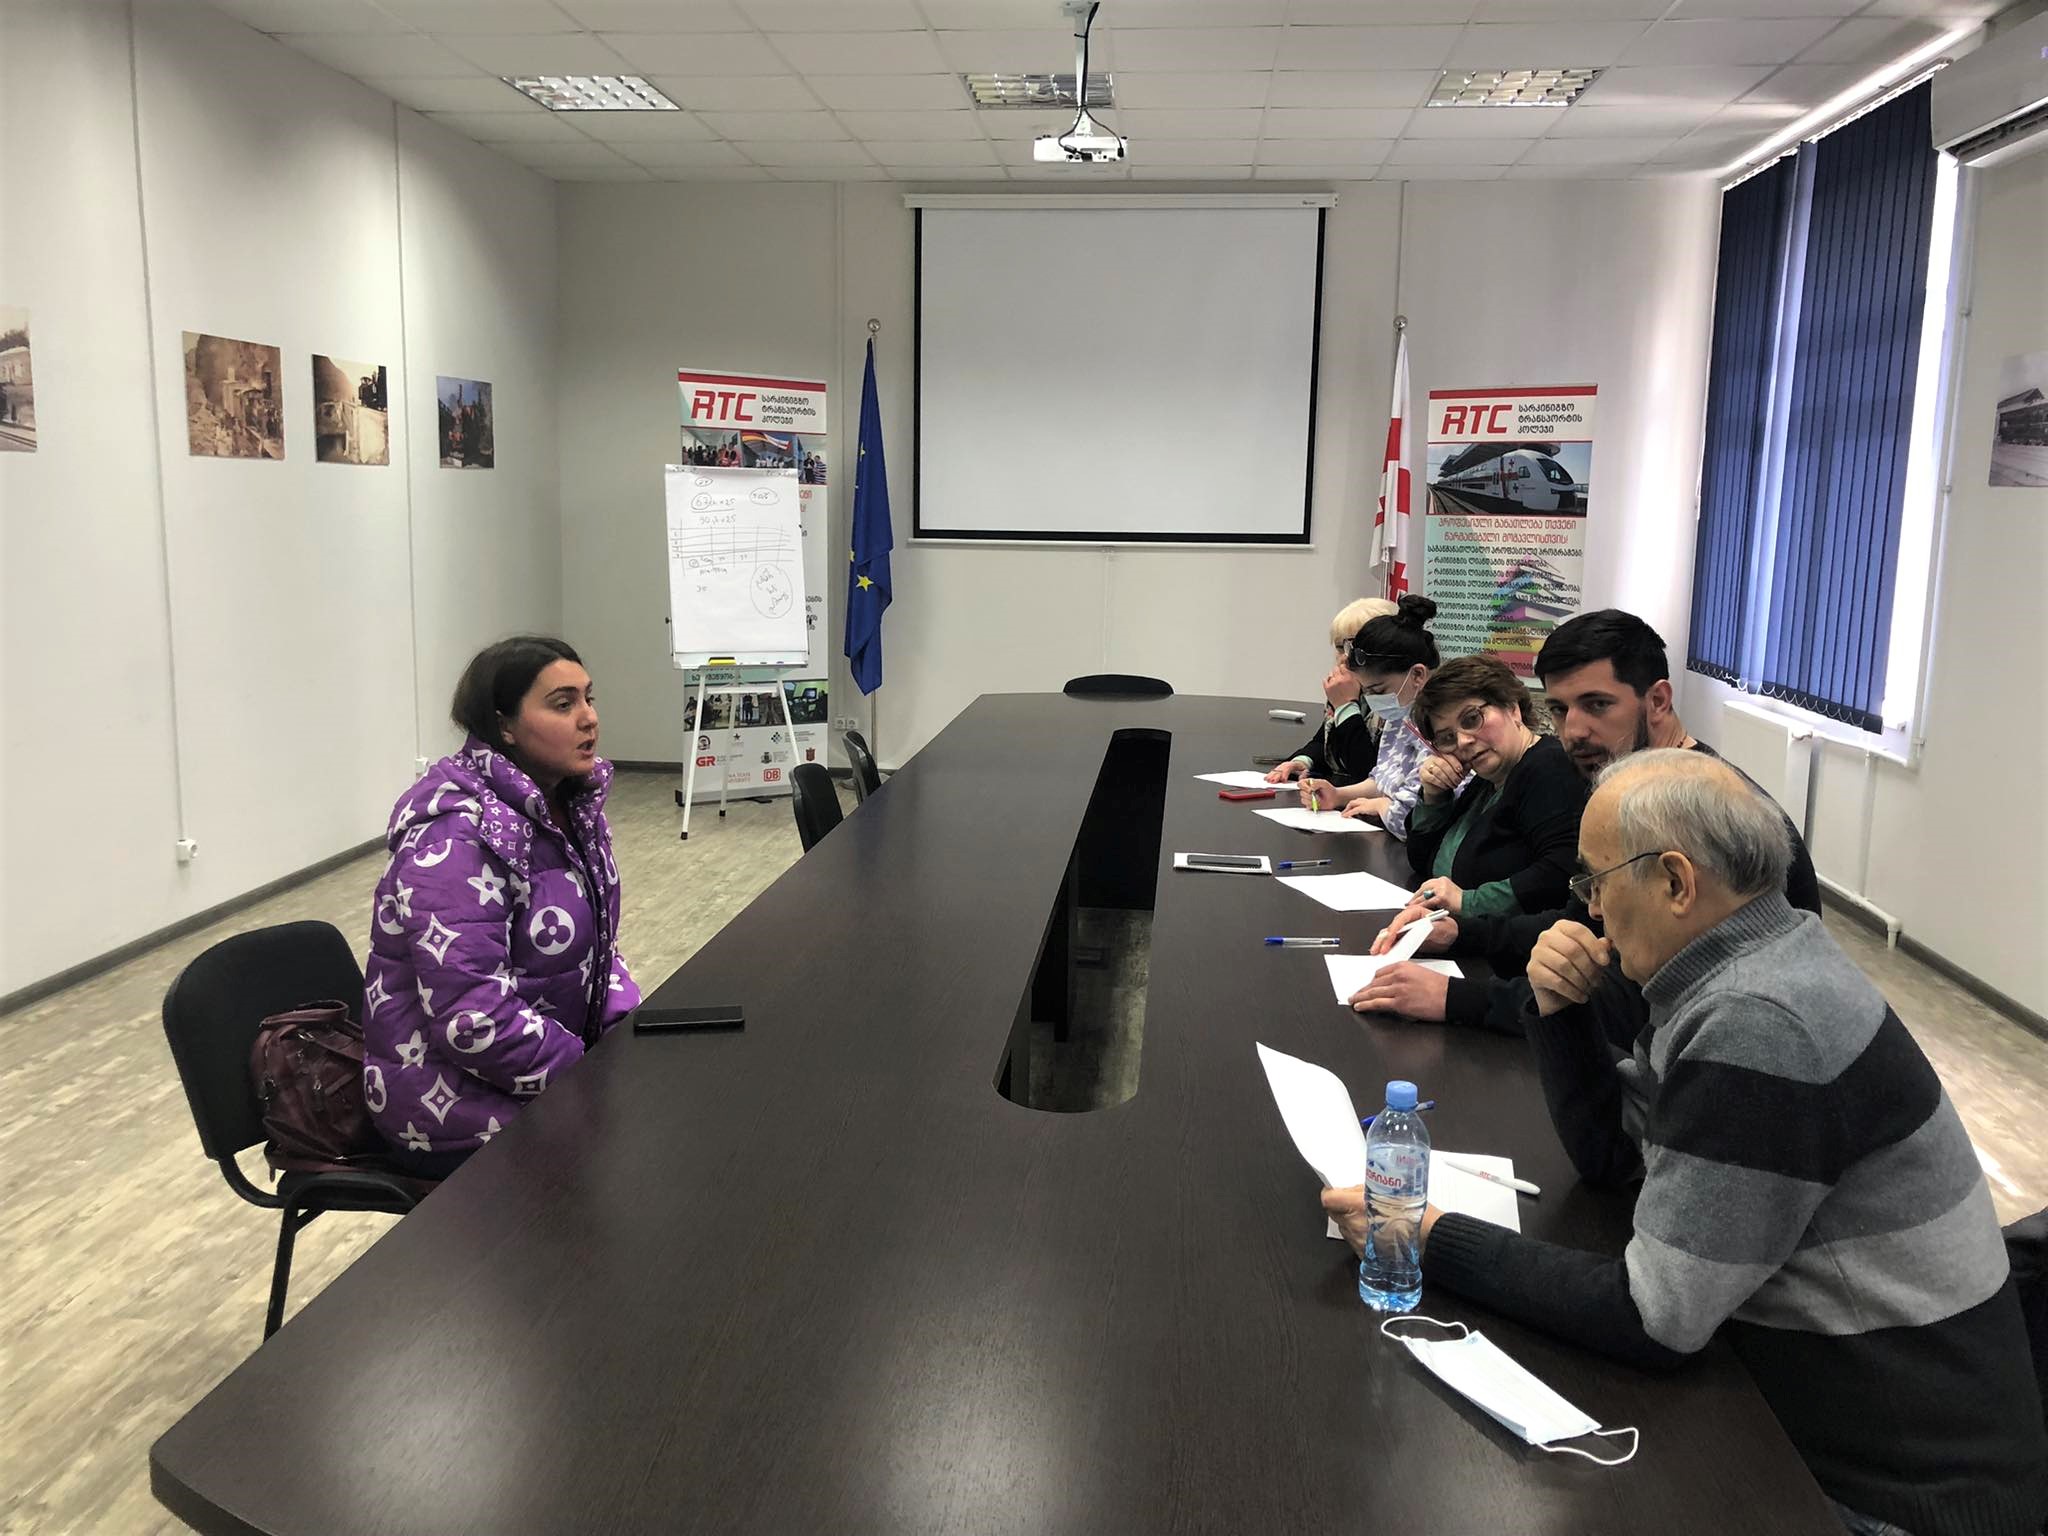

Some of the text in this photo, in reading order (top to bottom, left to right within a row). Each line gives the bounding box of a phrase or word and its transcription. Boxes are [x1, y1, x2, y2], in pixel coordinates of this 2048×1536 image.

[691, 390, 756, 421] RTC
[1518, 403, 1575, 412] სარკინიგზო
[1441, 405, 1513, 434] RTC
[1517, 414, 1583, 423] ტრანსპორტის
[1517, 425, 1554, 434] კოლეჯი
[696, 756, 716, 767] GR
[765, 770, 780, 780] DB
